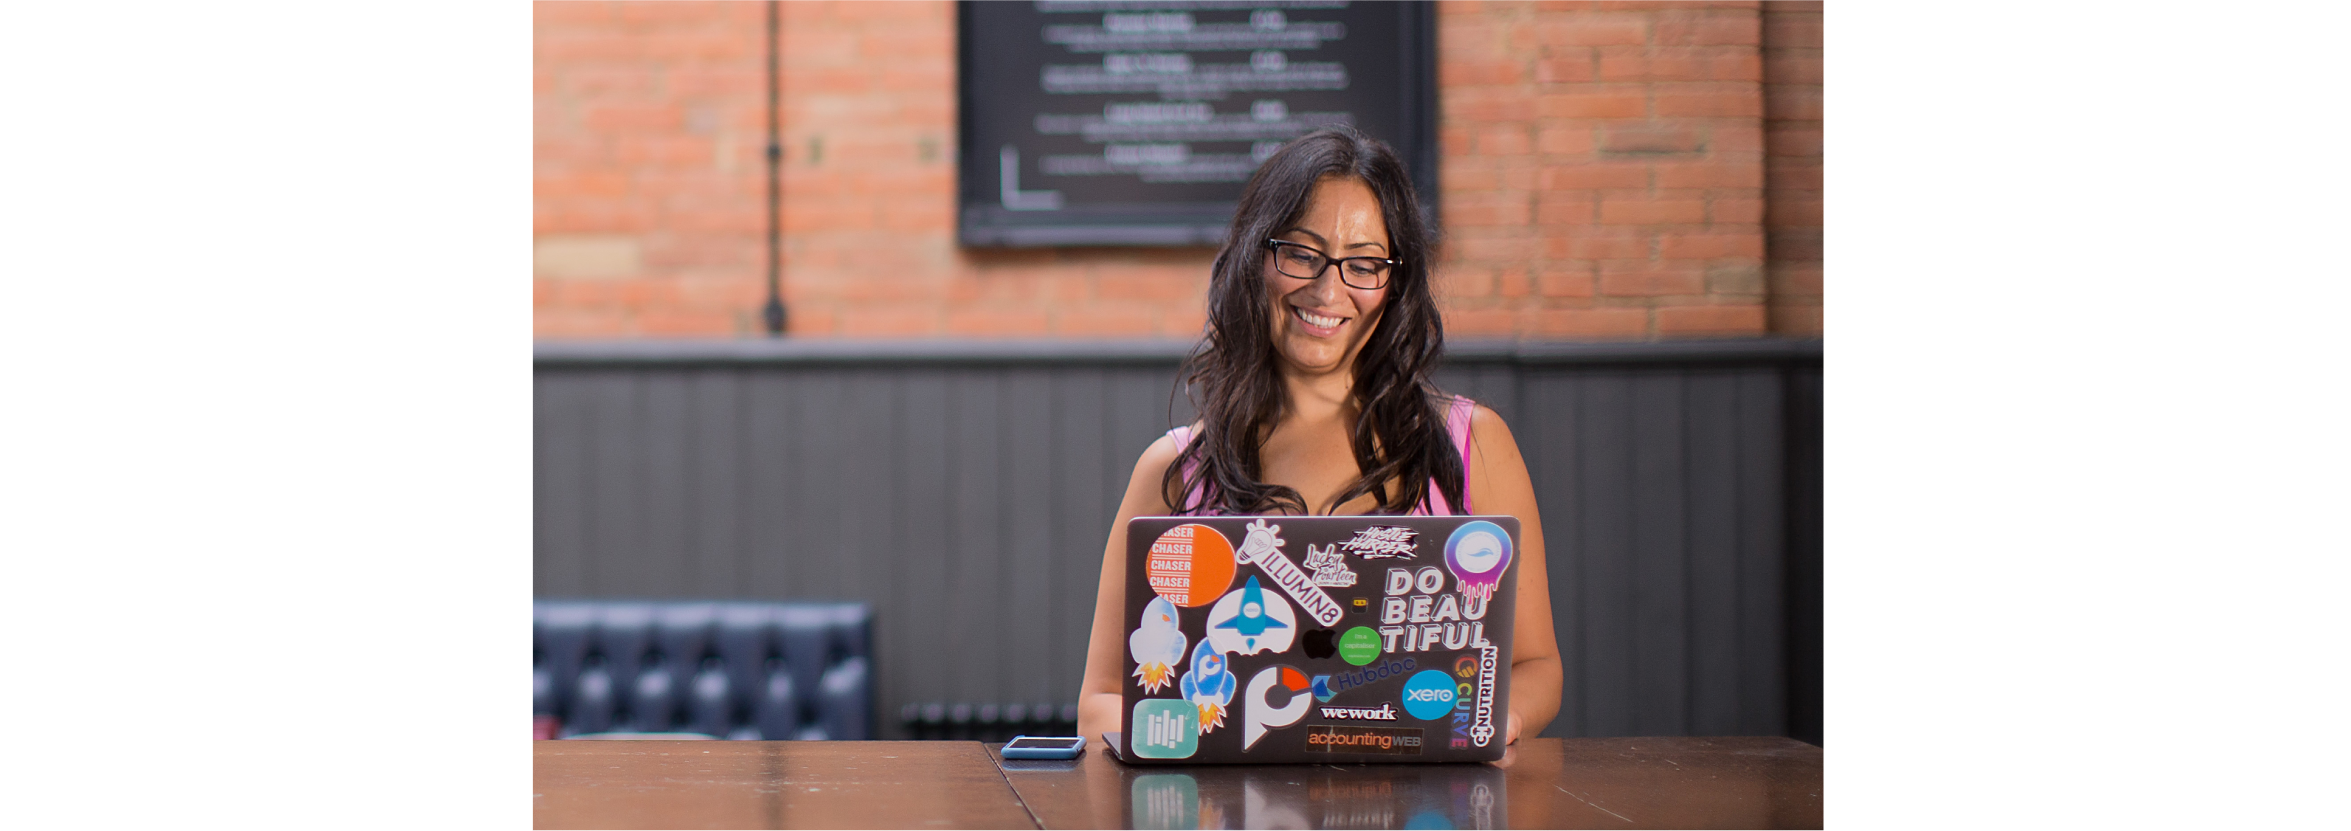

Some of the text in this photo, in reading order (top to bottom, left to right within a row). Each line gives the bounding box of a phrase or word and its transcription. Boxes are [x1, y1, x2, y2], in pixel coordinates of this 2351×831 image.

[1152, 543, 1193, 554] CHASER
[1304, 544, 1343, 572] Lucky
[1151, 560, 1191, 571] CHASER
[1313, 565, 1356, 584] Fourteen
[1150, 577, 1190, 588] CHASER
[1261, 551, 1339, 623] ILLUMIN8
[1385, 566, 1445, 596] DO
[1381, 593, 1488, 624] BEAU
[1379, 621, 1490, 653] TIFUL
[1337, 658, 1416, 690] Hubdoc
[1407, 688, 1453, 702] xero
[1320, 703, 1398, 720] wework
[1451, 682, 1473, 747] CURVE
[1308, 732, 1422, 749] accountingWEB
